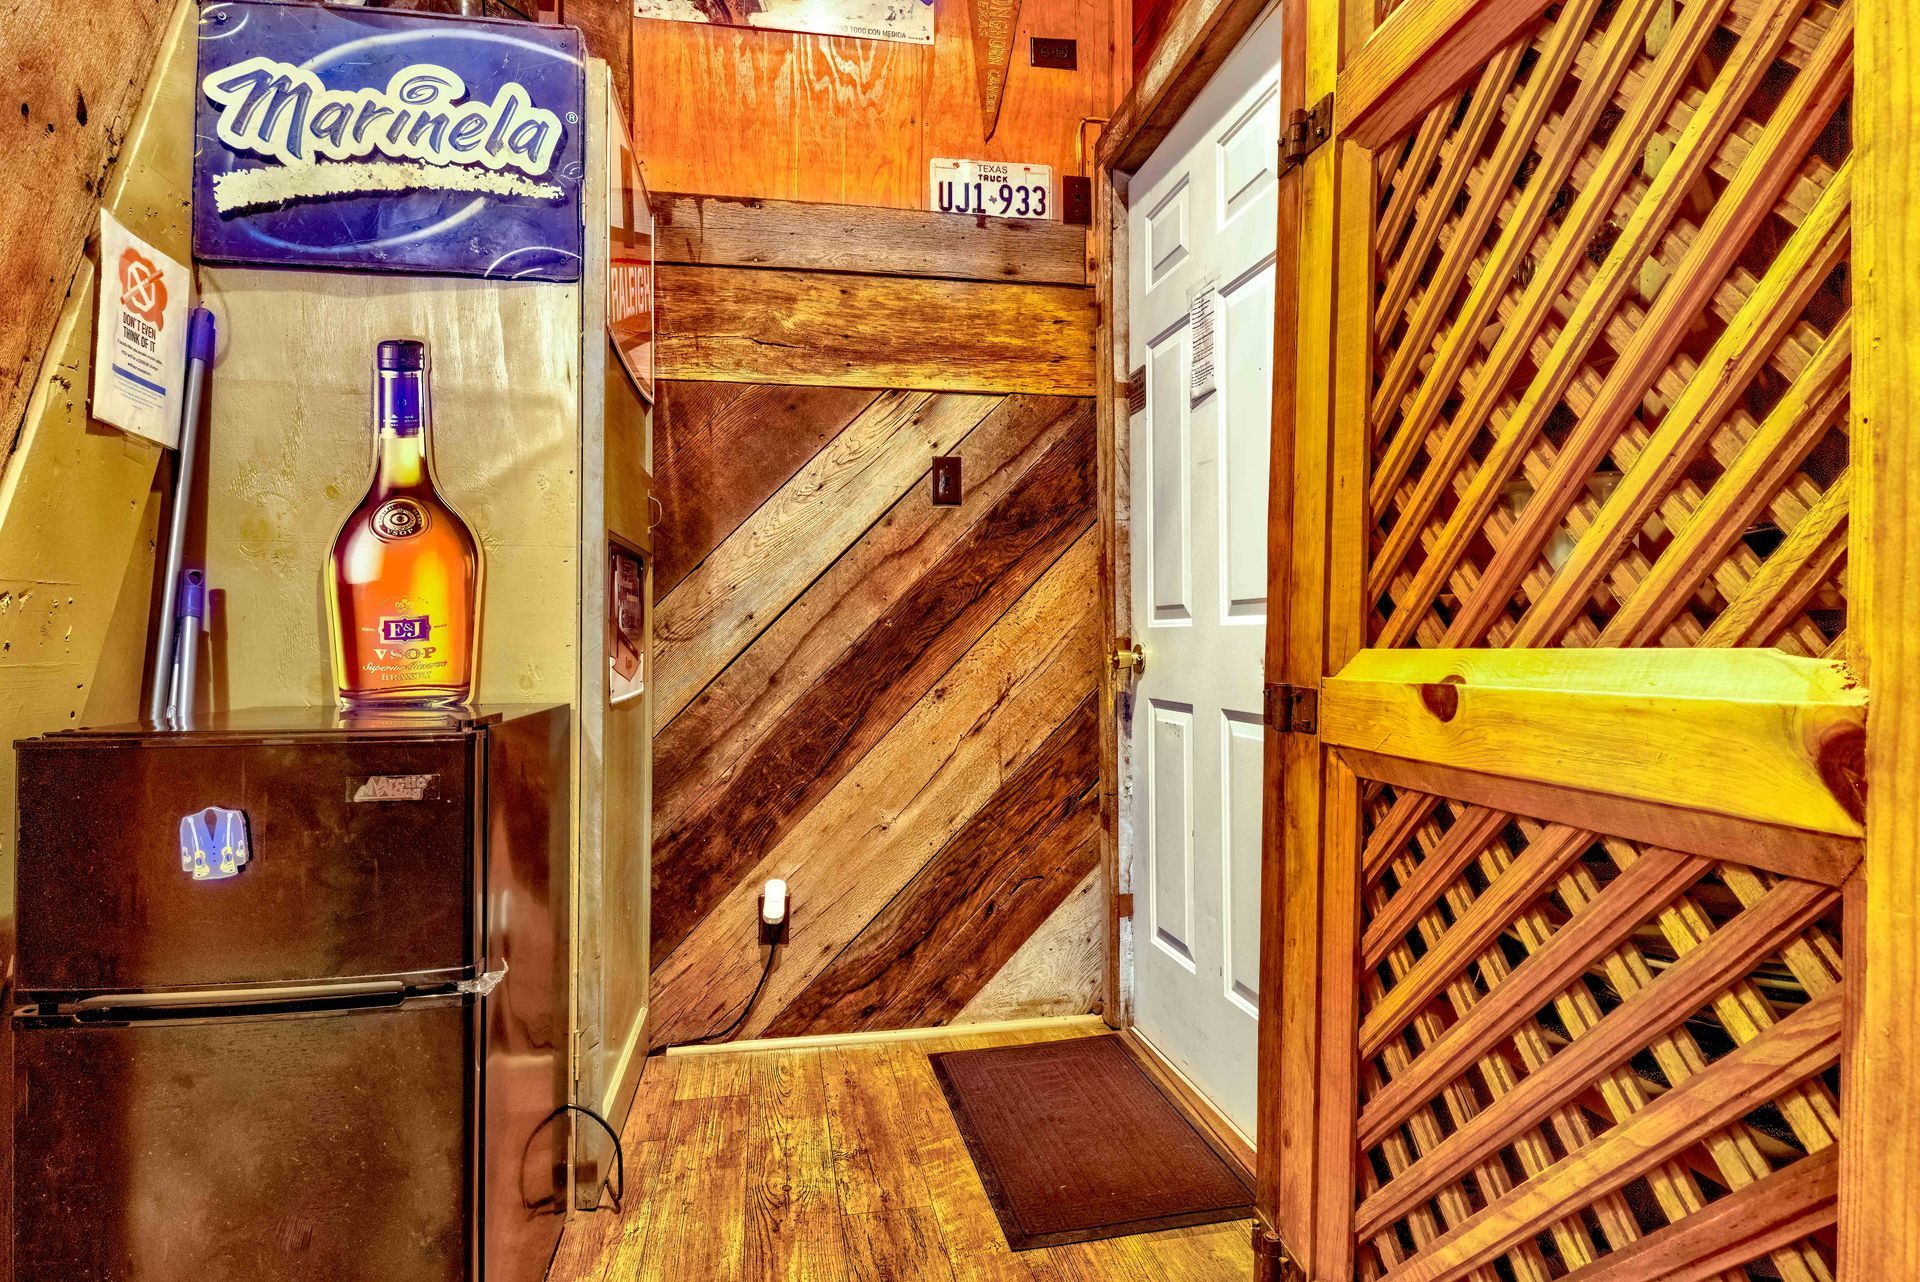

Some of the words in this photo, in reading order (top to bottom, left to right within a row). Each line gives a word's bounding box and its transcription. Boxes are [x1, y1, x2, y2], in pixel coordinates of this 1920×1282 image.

[977, 0, 989, 38] EXAS
[882, 30, 906, 38] MEDIDA
[988, 0, 1013, 65] ONGHORN
[216, 68, 550, 164] Marinela
[977, 164, 1008, 174] TEXAS
[978, 174, 1008, 183] TRUCK
[610, 266, 652, 323] RALEIGH
[123, 311, 141, 331] DON'T
[141, 322, 156, 340] EVEN
[123, 325, 140, 345] THINK
[141, 336, 149, 349] OF
[149, 340, 156, 353] IT
[388, 621, 422, 638] E&J
[362, 661, 403, 674] Superior
[381, 671, 432, 681] BRANDY
